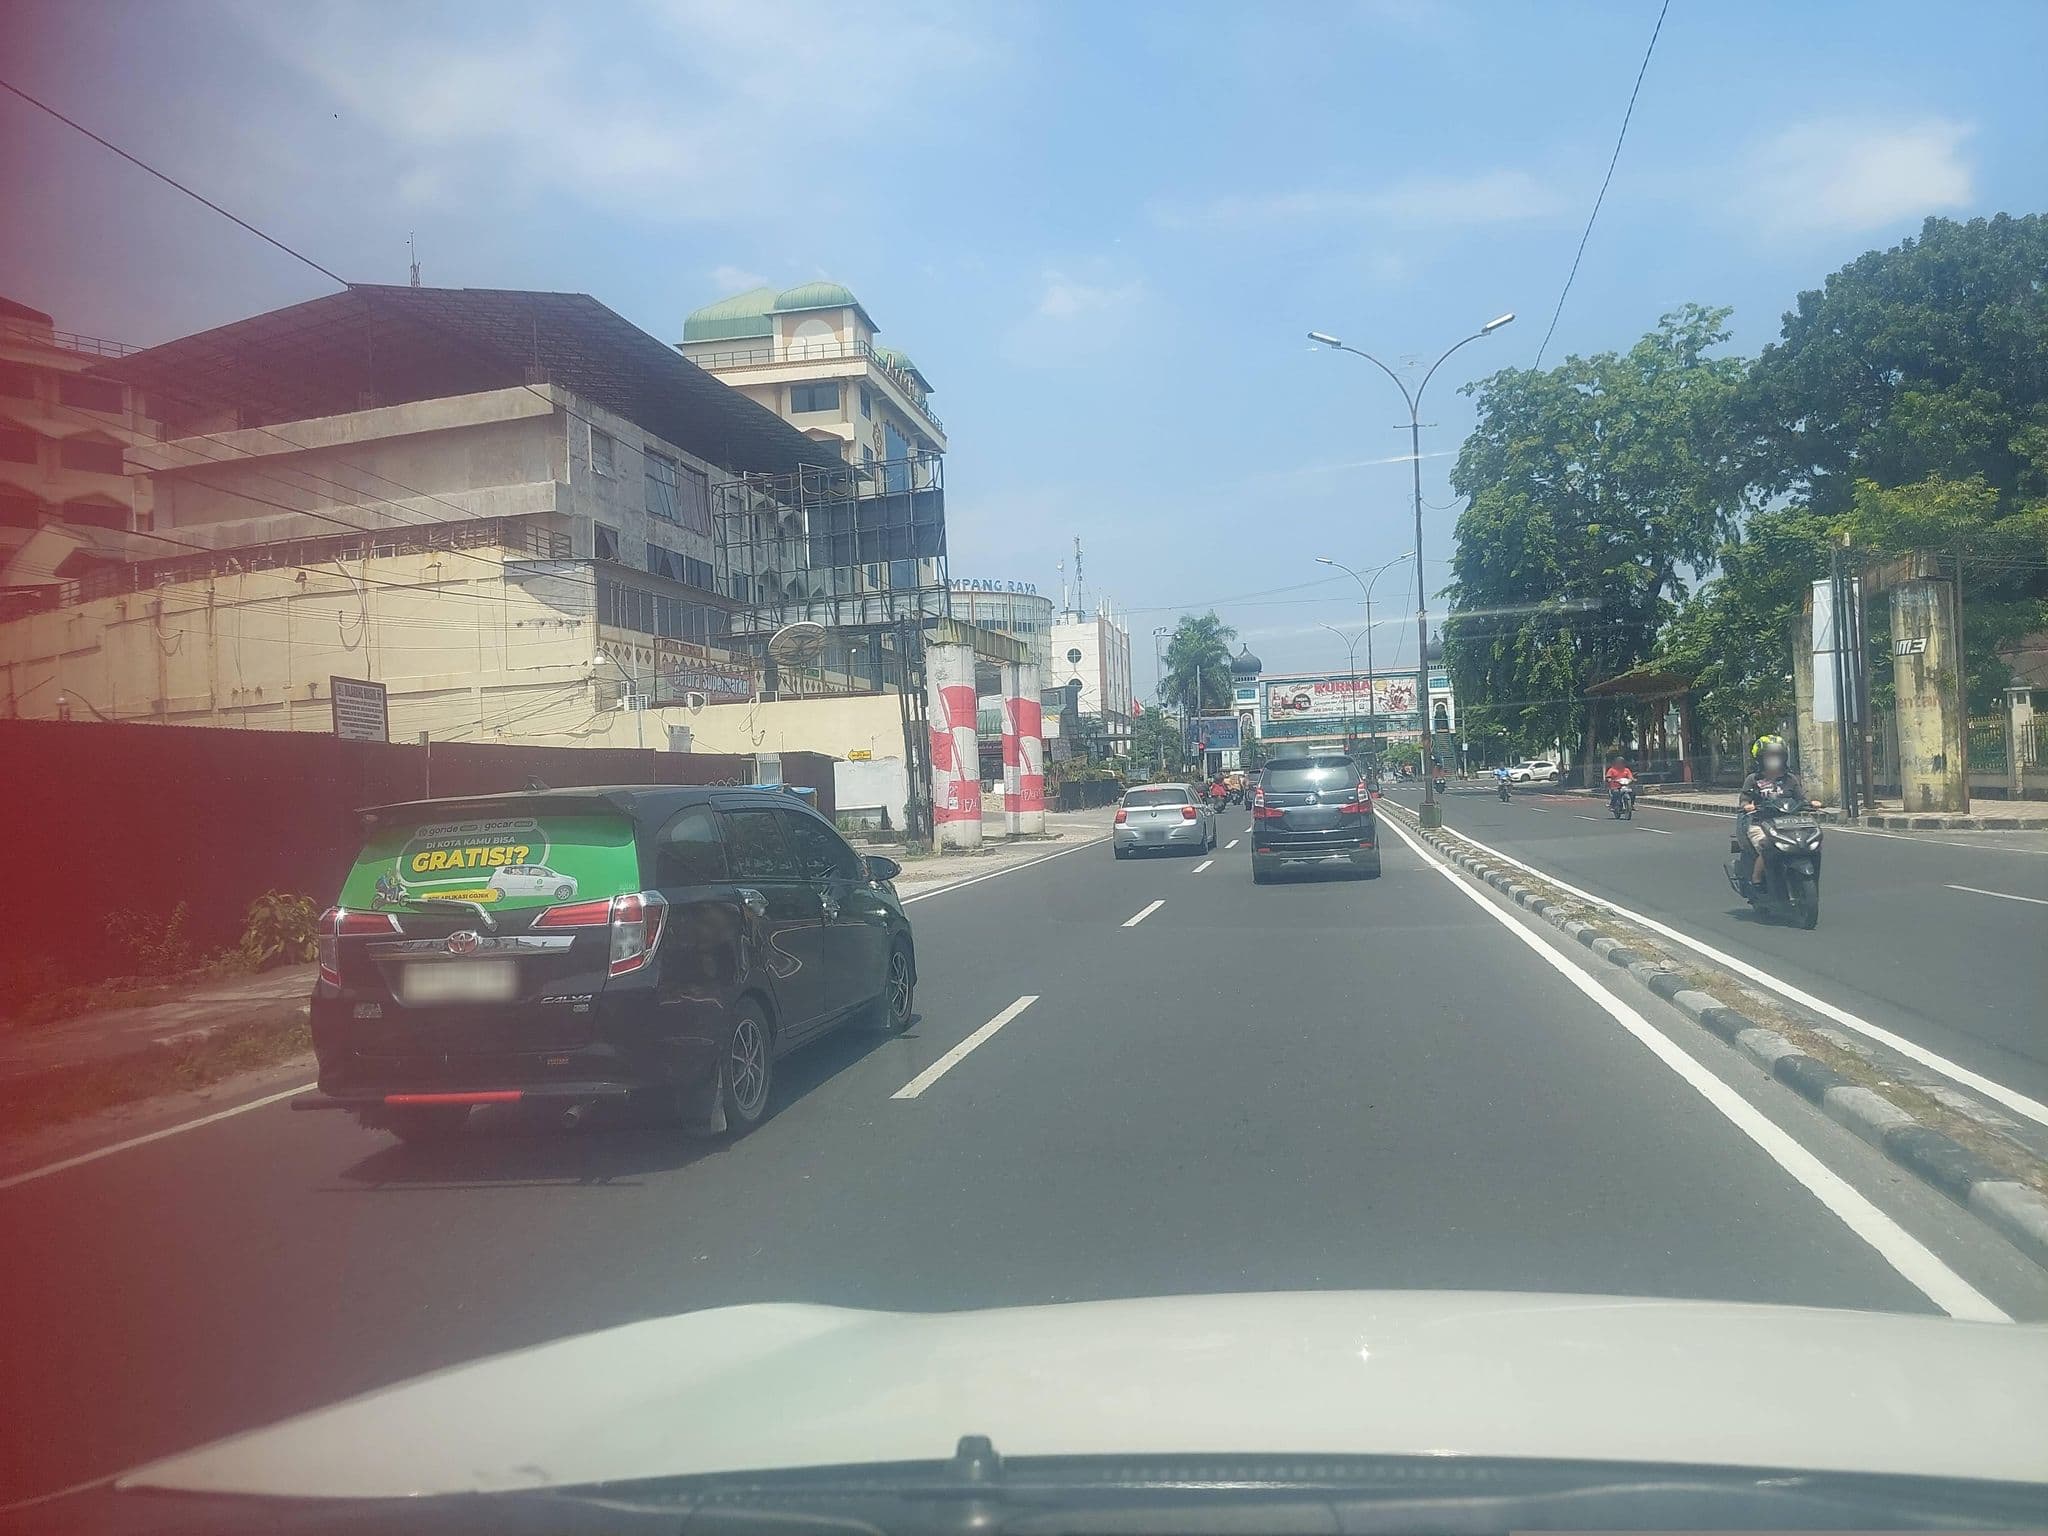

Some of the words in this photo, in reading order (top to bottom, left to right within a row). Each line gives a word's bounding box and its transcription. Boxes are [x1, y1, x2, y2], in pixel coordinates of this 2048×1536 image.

[1007, 580, 1037, 595] RAYA
[484, 821, 514, 831] gocar
[426, 842, 436, 850] DI
[437, 840, 461, 849] KOTA
[463, 837, 491, 846] KAMU
[493, 836, 516, 844] BISA
[412, 845, 530, 873] GRATIS!?
